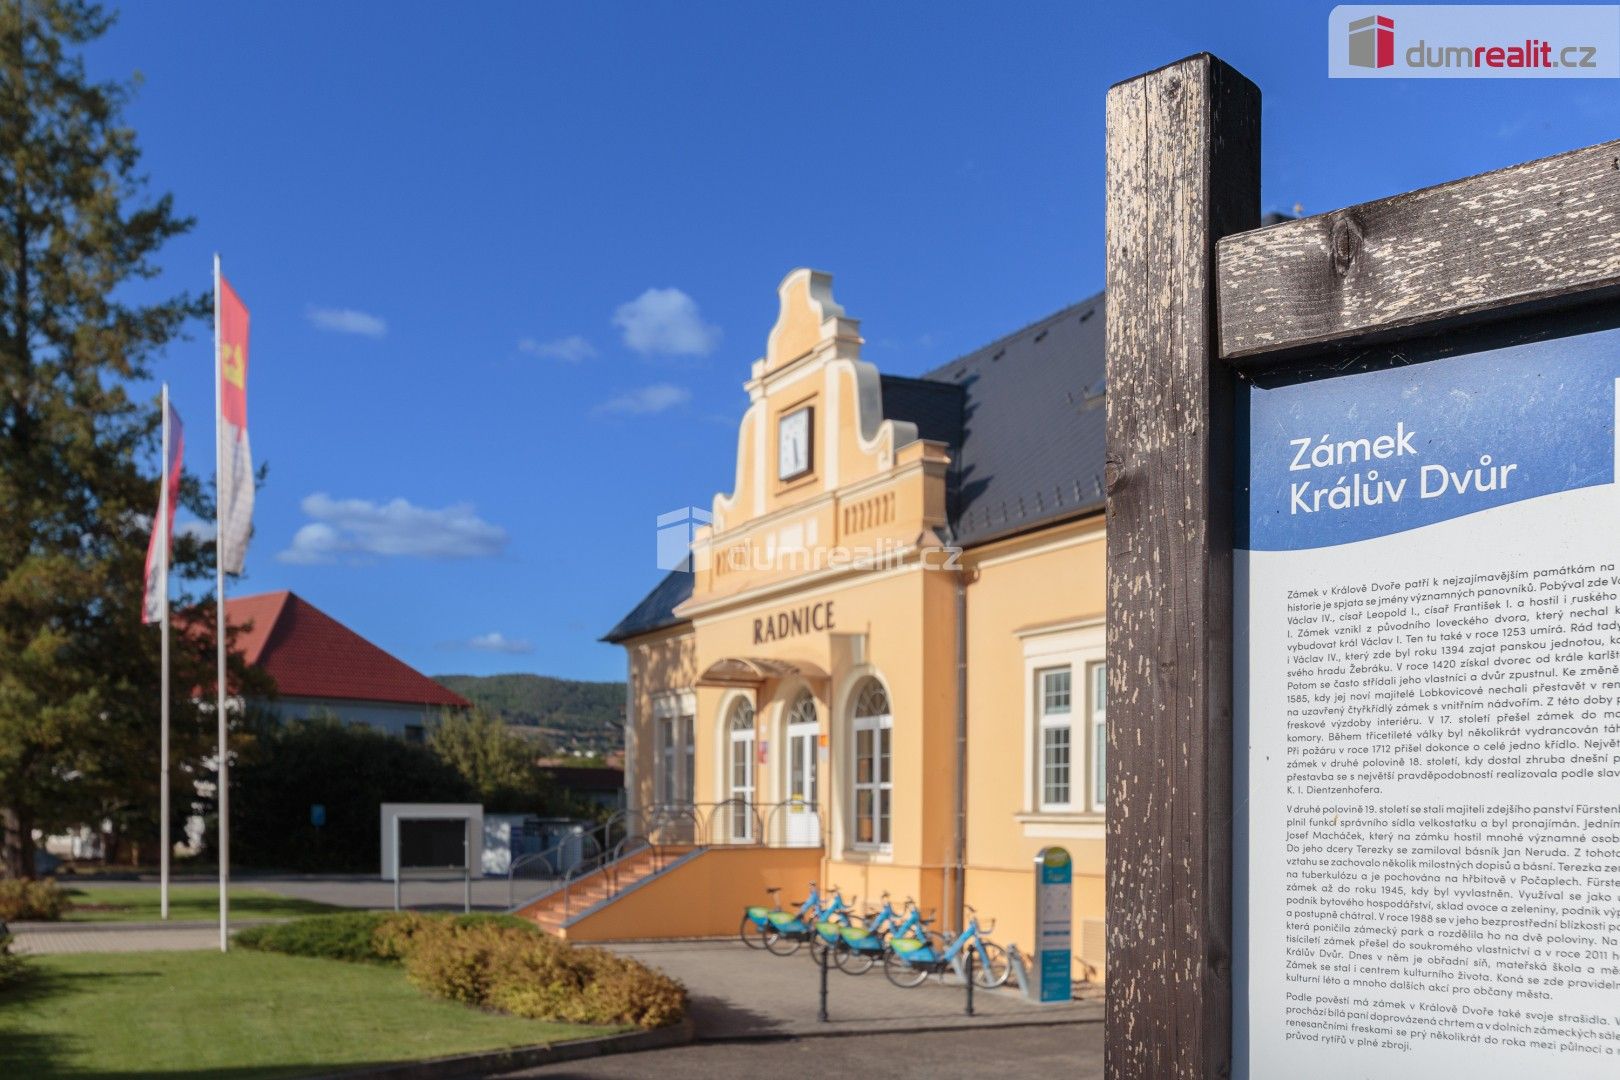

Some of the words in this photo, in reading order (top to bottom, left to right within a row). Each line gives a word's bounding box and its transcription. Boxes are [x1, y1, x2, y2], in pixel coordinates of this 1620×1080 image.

[1289, 421, 1417, 471] Zámek
[1290, 470, 1407, 515] Králův
[1420, 454, 1517, 499] Dvůr
[1287, 587, 1319, 599] Zámek
[1330, 583, 1367, 595] Králově
[1370, 581, 1401, 592] Dvoře
[1404, 578, 1429, 591] patří
[1442, 569, 1529, 587] nejzajímavějším
[1532, 564, 1595, 580] památkám
[1599, 563, 1615, 572] na
[1287, 600, 1322, 612] historie
[1321, 600, 1332, 612] je
[1333, 598, 1364, 610] spjata
[1365, 598, 1377, 606] se
[1376, 594, 1409, 607] jmény
[1409, 587, 1475, 604] významných
[1477, 582, 1537, 599] panovníků.
[1539, 578, 1585, 592] Pobýval
[1586, 576, 1609, 588] zde
[753, 601, 835, 645] RADNICE
[1286, 666, 1314, 677] svého
[1317, 665, 1346, 676] hradu
[1348, 659, 1393, 674] Žebráku.
[1405, 662, 1429, 671] roce
[1432, 659, 1456, 669] 1420
[1458, 656, 1489, 668] získal
[1493, 656, 1531, 666] dvorec
[1535, 653, 1551, 664] od
[1554, 651, 1584, 662] krále
[1286, 694, 1310, 704] 1585,
[1314, 692, 1331, 704] kdy
[1333, 692, 1346, 704] jej
[1349, 690, 1371, 701] noví
[1374, 688, 1415, 701] majitelé
[1419, 685, 1484, 698] Lobkovicové
[1487, 683, 1528, 695] nechali
[1531, 680, 1586, 695] přestavět
[1286, 719, 1326, 729] freskové
[1330, 717, 1372, 730] výzdoby
[1376, 716, 1422, 726] interiéru.
[1439, 714, 1452, 724] 17.
[1458, 713, 1491, 724] století
[1496, 711, 1530, 725] přešel
[1536, 709, 1574, 721] zámek
[1579, 709, 1597, 719] do
[1286, 733, 1324, 744] komory.
[1328, 731, 1362, 741] Během
[1365, 729, 1412, 740] třicetileté
[1416, 728, 1444, 740] války
[1447, 728, 1463, 740] byl
[1467, 726, 1521, 737] několikrát
[1524, 724, 1599, 738] vydrancován
[1286, 771, 1334, 783] přestavba
[1336, 773, 1348, 781] se
[1357, 770, 1395, 783] největší
[1397, 768, 1493, 782] pravděpodobností
[1496, 768, 1558, 779] realizovala
[1560, 767, 1594, 780] podle
[1306, 783, 1382, 794] Dientzenhofera.
[1286, 817, 1306, 829] plnil
[1339, 817, 1389, 829] správního
[1390, 817, 1416, 827] sídla
[1417, 817, 1477, 828] velkostatku
[1491, 818, 1508, 830] byl
[1511, 818, 1580, 830] pronajímán.
[1284, 829, 1309, 842] Josef
[1312, 830, 1365, 841] Macháček,
[1368, 831, 1394, 843] který
[1397, 833, 1411, 841] na
[1414, 831, 1449, 841] zámku
[1453, 831, 1482, 842] hostil
[1485, 832, 1524, 842] mnohé
[1527, 832, 1586, 845] významné
[1286, 856, 1317, 866] vztahu
[1329, 856, 1381, 867] zachovalo
[1382, 857, 1417, 868] několik
[1417, 858, 1474, 871] milostných
[1474, 860, 1511, 872] dopisů
[1521, 861, 1556, 871] básní.
[1557, 861, 1602, 872] Terezka
[1301, 869, 1357, 880] tuberkulózu
[1370, 871, 1381, 883] je
[1383, 871, 1441, 883] pochována
[1444, 875, 1458, 883] na
[1462, 873, 1506, 884] hřbitově
[1520, 874, 1582, 888] Počaplech.
[1285, 895, 1318, 906] podnik
[1319, 895, 1365, 909] bytového
[1366, 897, 1434, 911] hospodářství,
[1435, 900, 1464, 911] sklad
[1466, 904, 1499, 912] ovoce
[1510, 903, 1559, 916] zeleniny,
[1560, 905, 1601, 917] podnik
[1285, 972, 1320, 983] kulturní
[1322, 975, 1341, 985] léto
[1352, 977, 1387, 988] mnoho
[1389, 979, 1425, 991] dalších
[1428, 982, 1450, 992] akcí
[1451, 986, 1471, 996] pro
[1472, 984, 1513, 999] občany
[1285, 991, 1312, 1002] Podle
[1315, 994, 1349, 1007] pověstí
[1352, 997, 1369, 1007] má
[1372, 998, 1406, 1010] zámek
[1418, 1001, 1458, 1014] Králově
[1461, 1004, 1494, 1016] Dvoře
[1497, 1008, 1521, 1018] také
[1525, 1011, 1554, 1023] svoje
[1285, 1029, 1319, 1041] průvod
[1321, 1034, 1346, 1044] rytířů
[1356, 1037, 1378, 1047] plné
